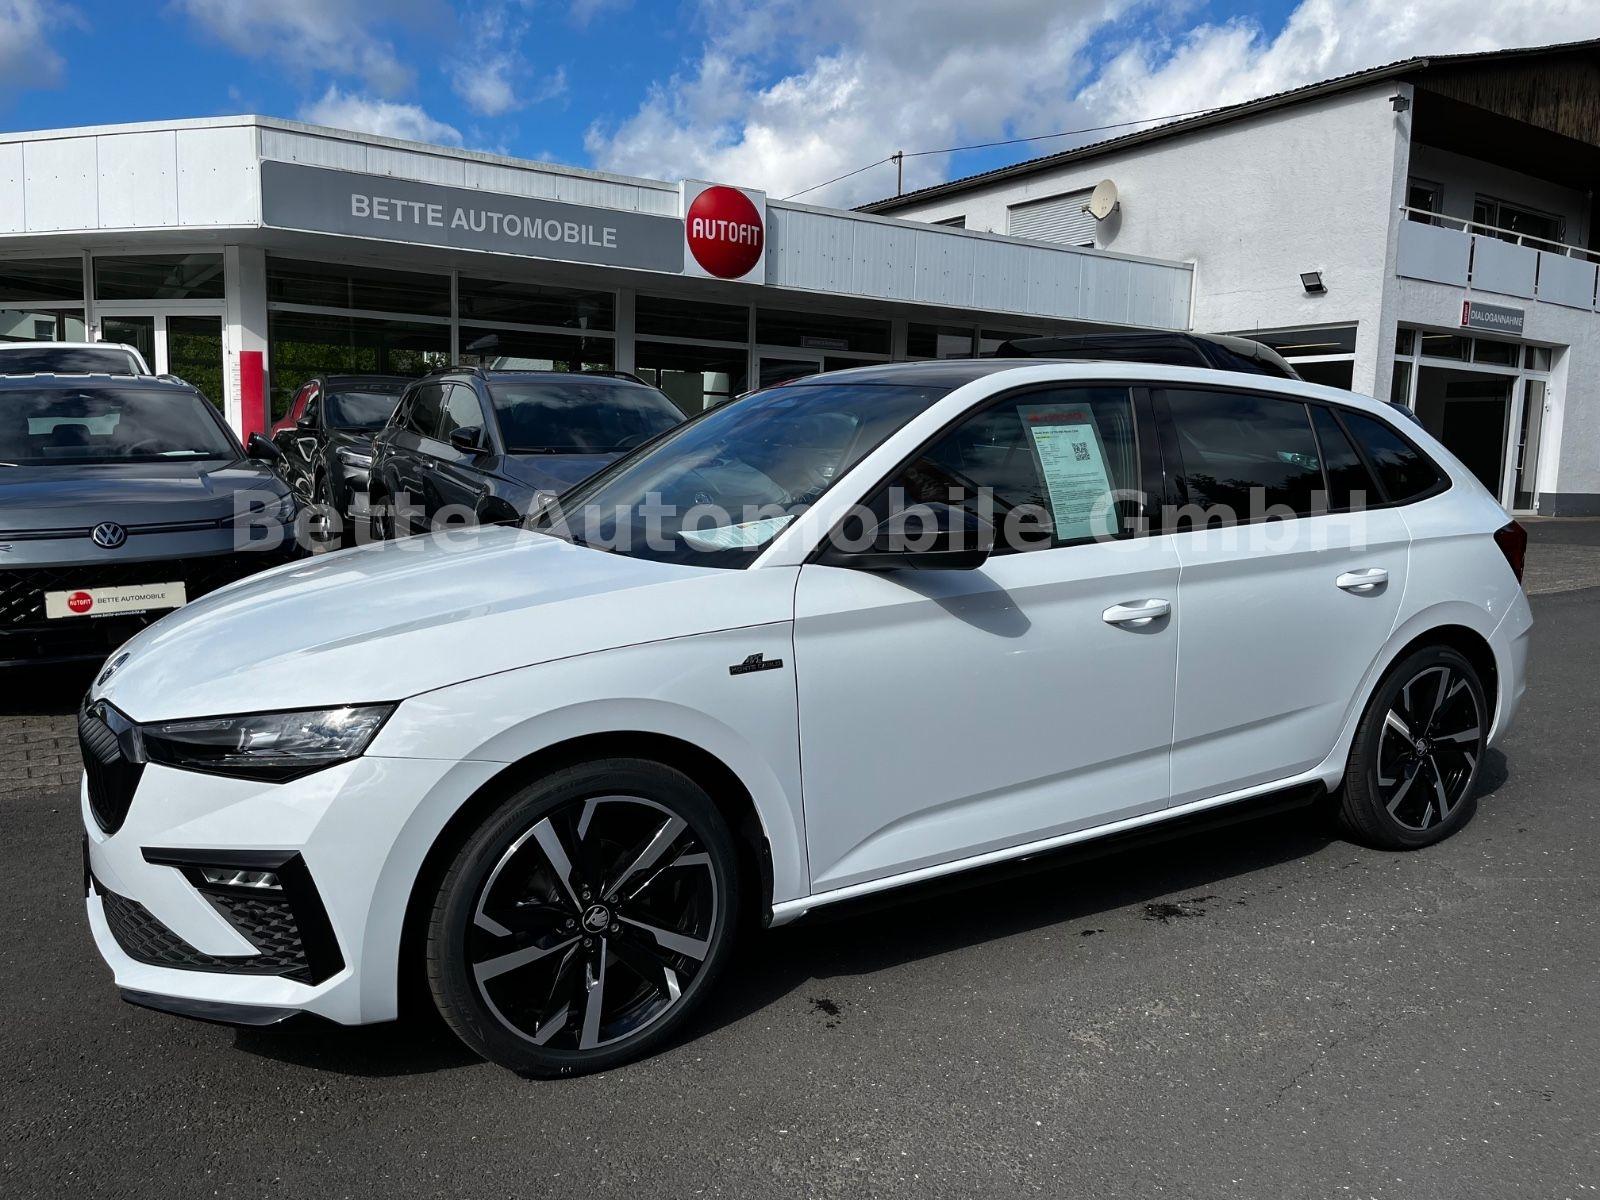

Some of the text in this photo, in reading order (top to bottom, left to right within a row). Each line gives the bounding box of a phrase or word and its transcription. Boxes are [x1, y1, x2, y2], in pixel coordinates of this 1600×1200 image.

[351, 193, 617, 248] BETTE AUTOMOBILE
[692, 217, 760, 247] AUTOFIT
[1470, 310, 1522, 326] DIALOGANNAHME
[69, 598, 91, 606] AUTOFIT
[97, 593, 166, 604] BETTE AUTOMOBILE
